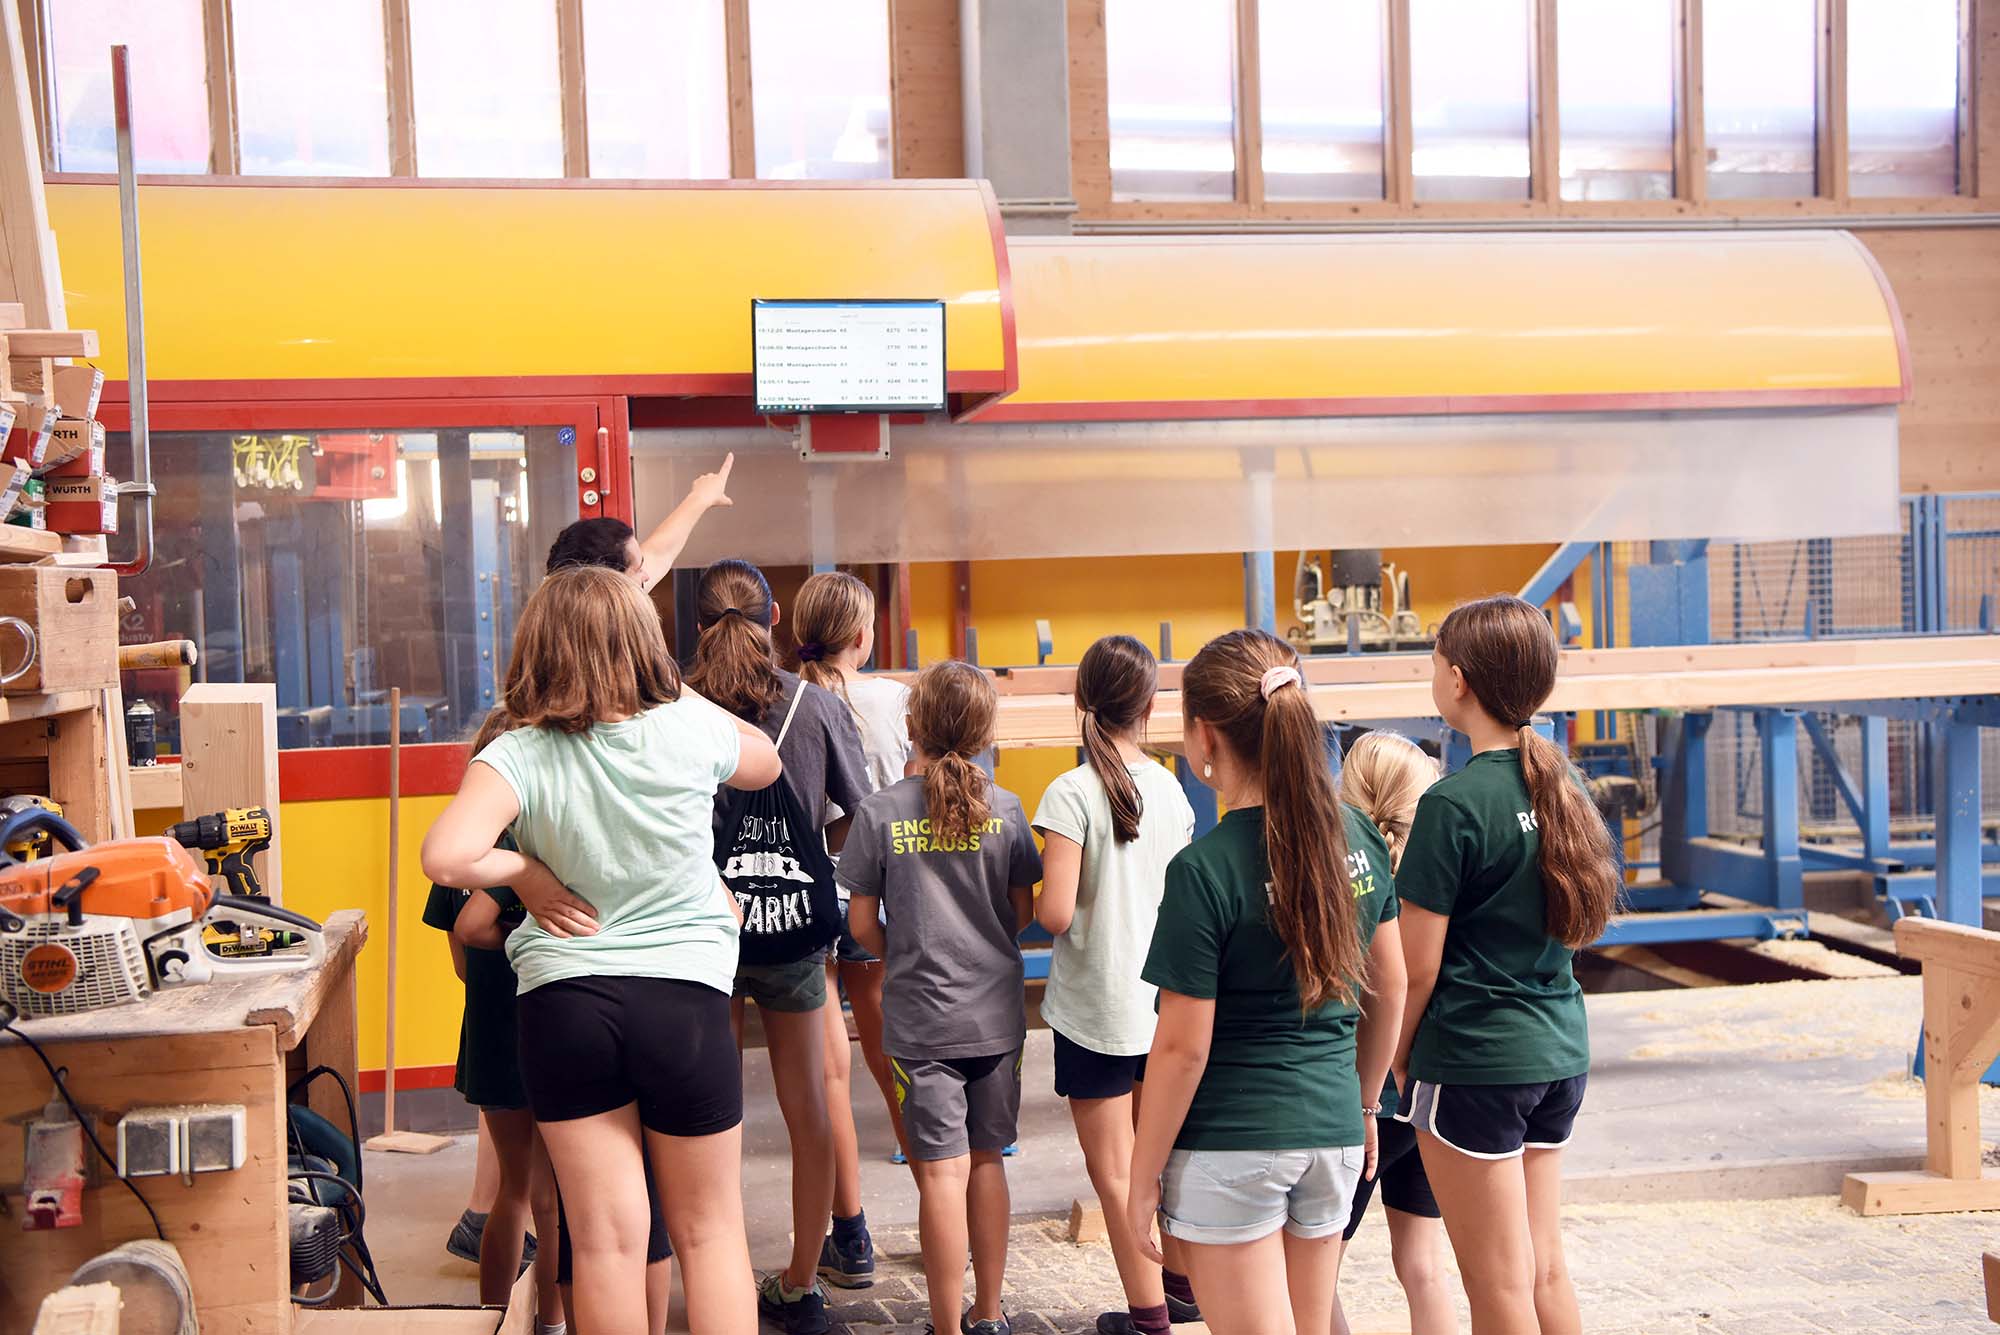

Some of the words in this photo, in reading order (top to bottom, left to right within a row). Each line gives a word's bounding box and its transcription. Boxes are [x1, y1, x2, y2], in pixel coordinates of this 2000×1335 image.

[53, 430, 78, 439] RTH
[120, 632, 154, 643] dustry
[890, 818, 1004, 838] ENGRT
[892, 834, 981, 855] STRAUSS
[1350, 874, 1376, 899] OLZ
[734, 889, 813, 935] TARK!
